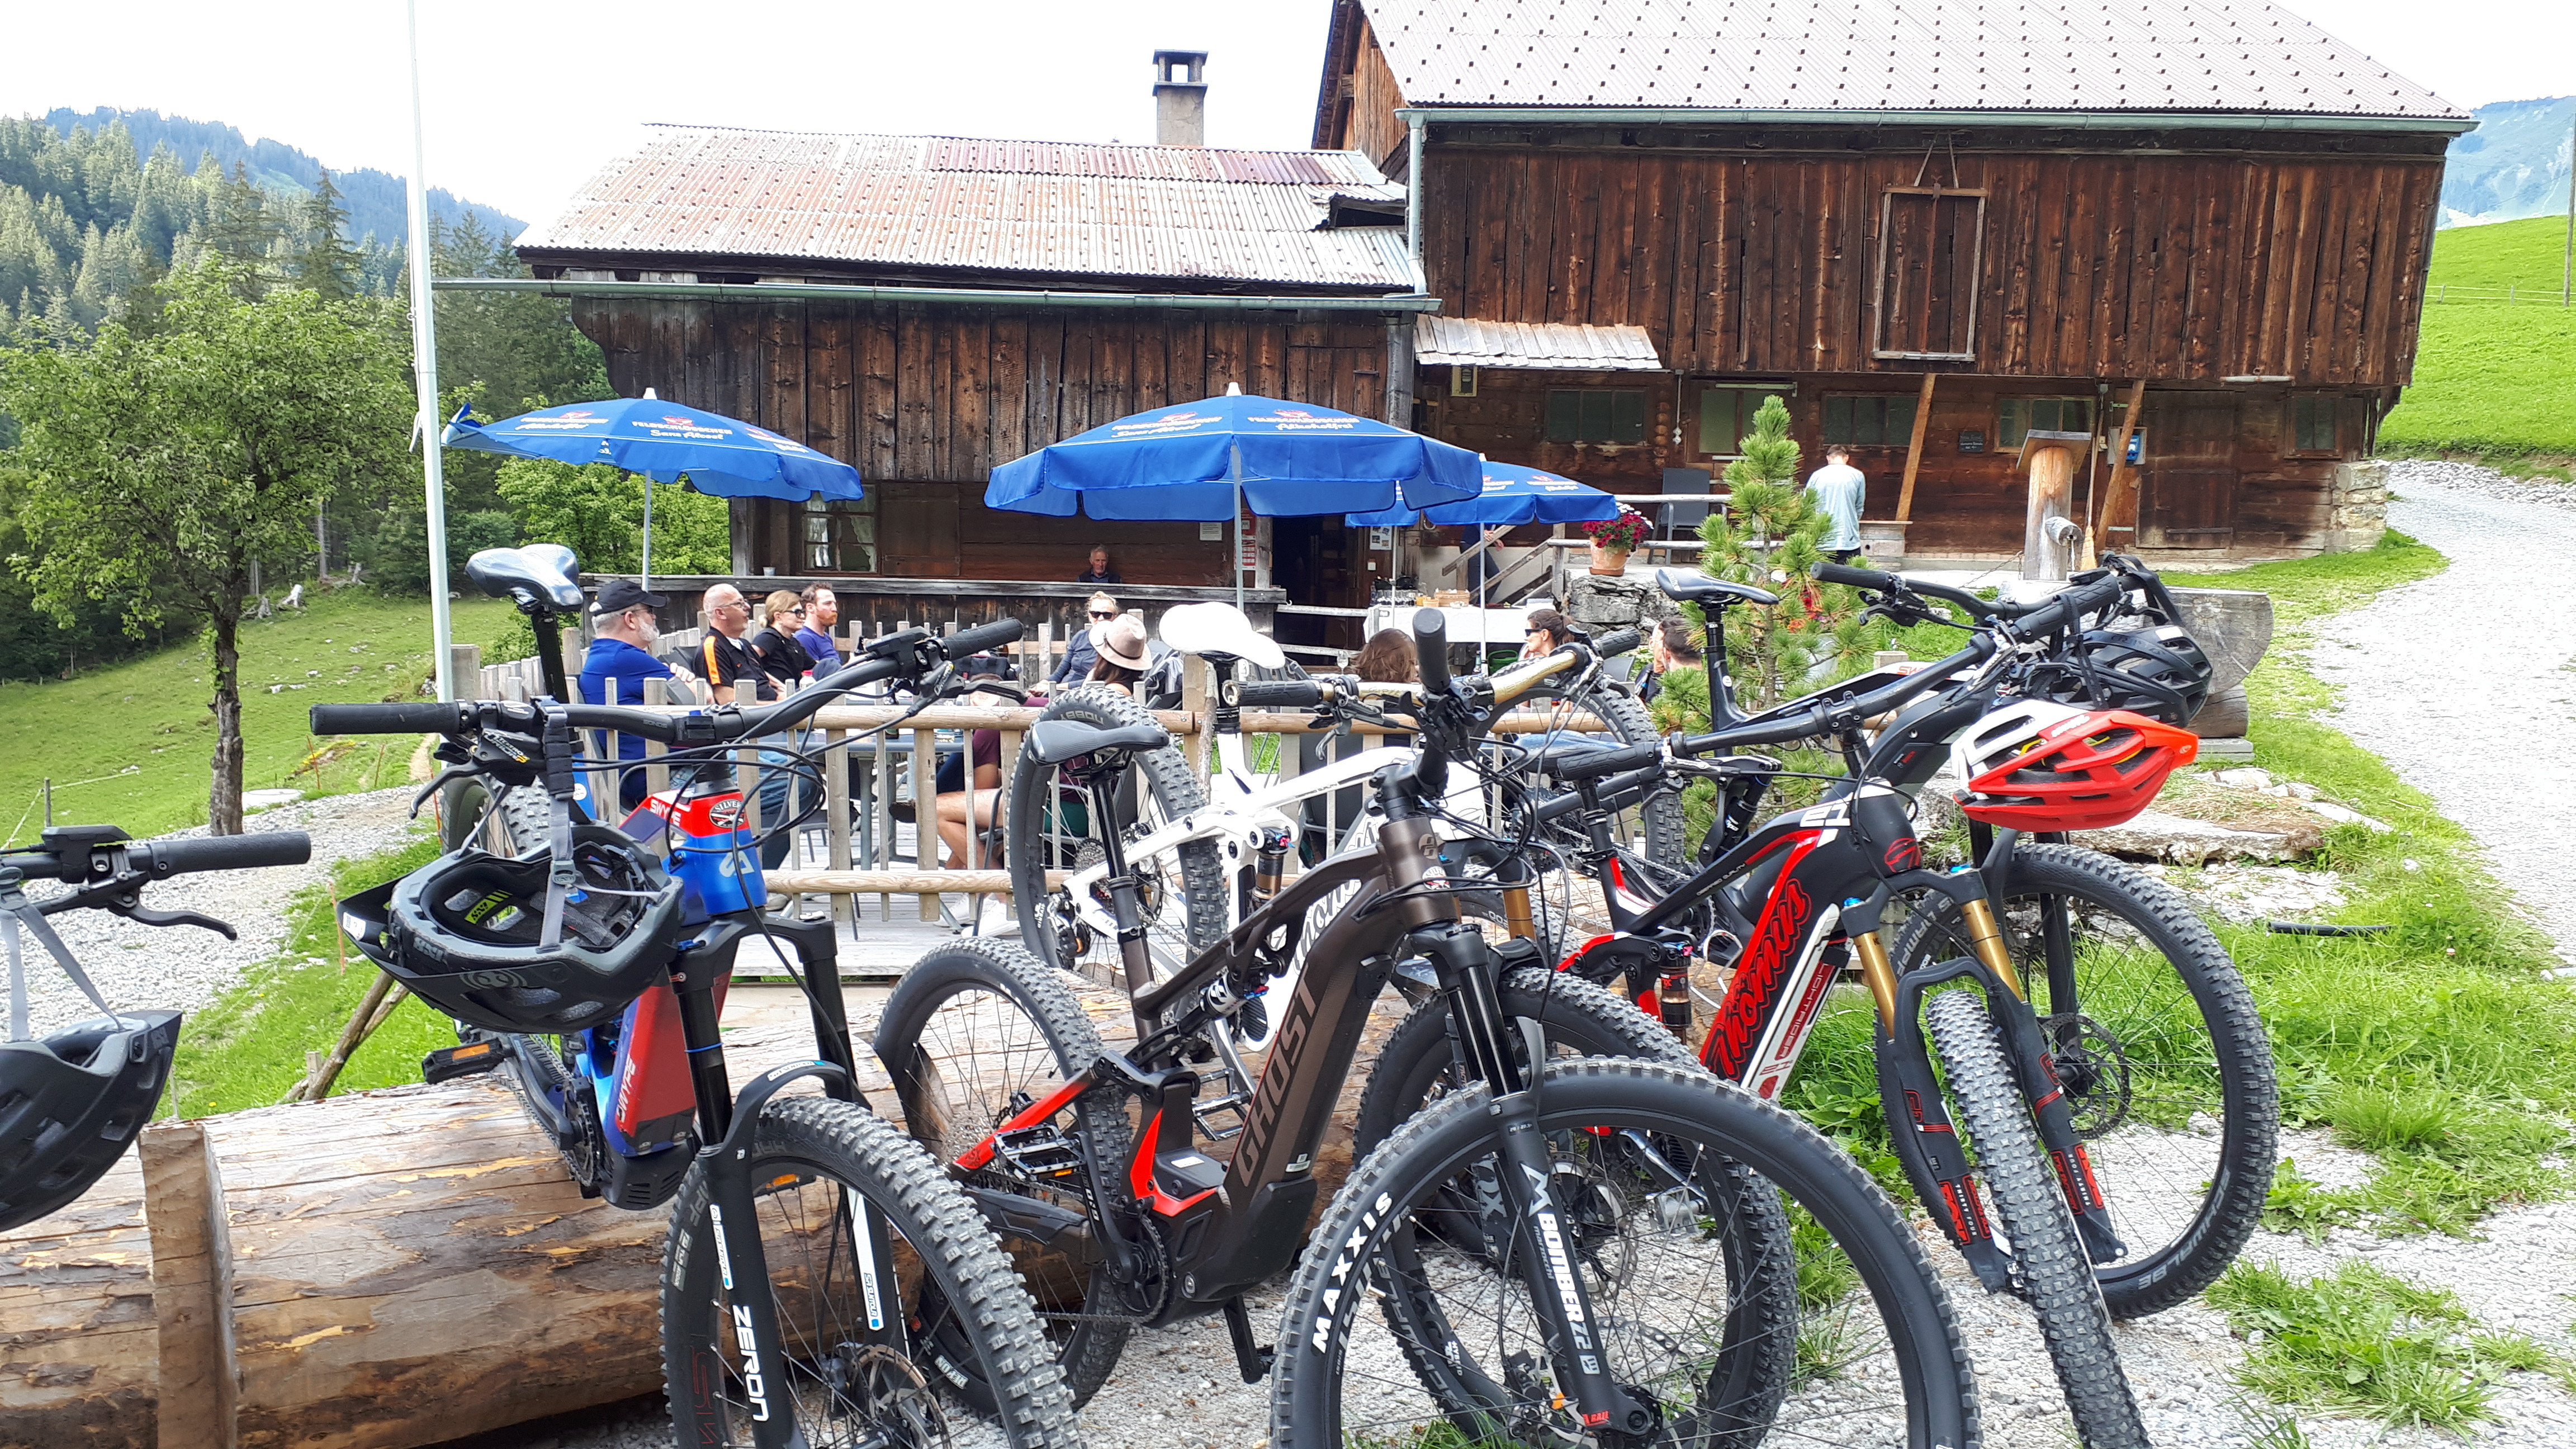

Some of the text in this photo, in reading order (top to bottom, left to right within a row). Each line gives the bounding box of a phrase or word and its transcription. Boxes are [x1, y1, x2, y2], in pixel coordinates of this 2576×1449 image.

[1235, 962, 1317, 1188] GHOST
[1537, 1213, 1585, 1322] BOMBER
[1955, 1184, 1977, 1237] THIRTY FOUR
[2138, 1164, 2231, 1290] SCHWALBE
[865, 1286, 878, 1317] SUNTOUR
[1311, 1191, 1393, 1354] MAXXIS
[732, 1304, 770, 1422] ZERON
